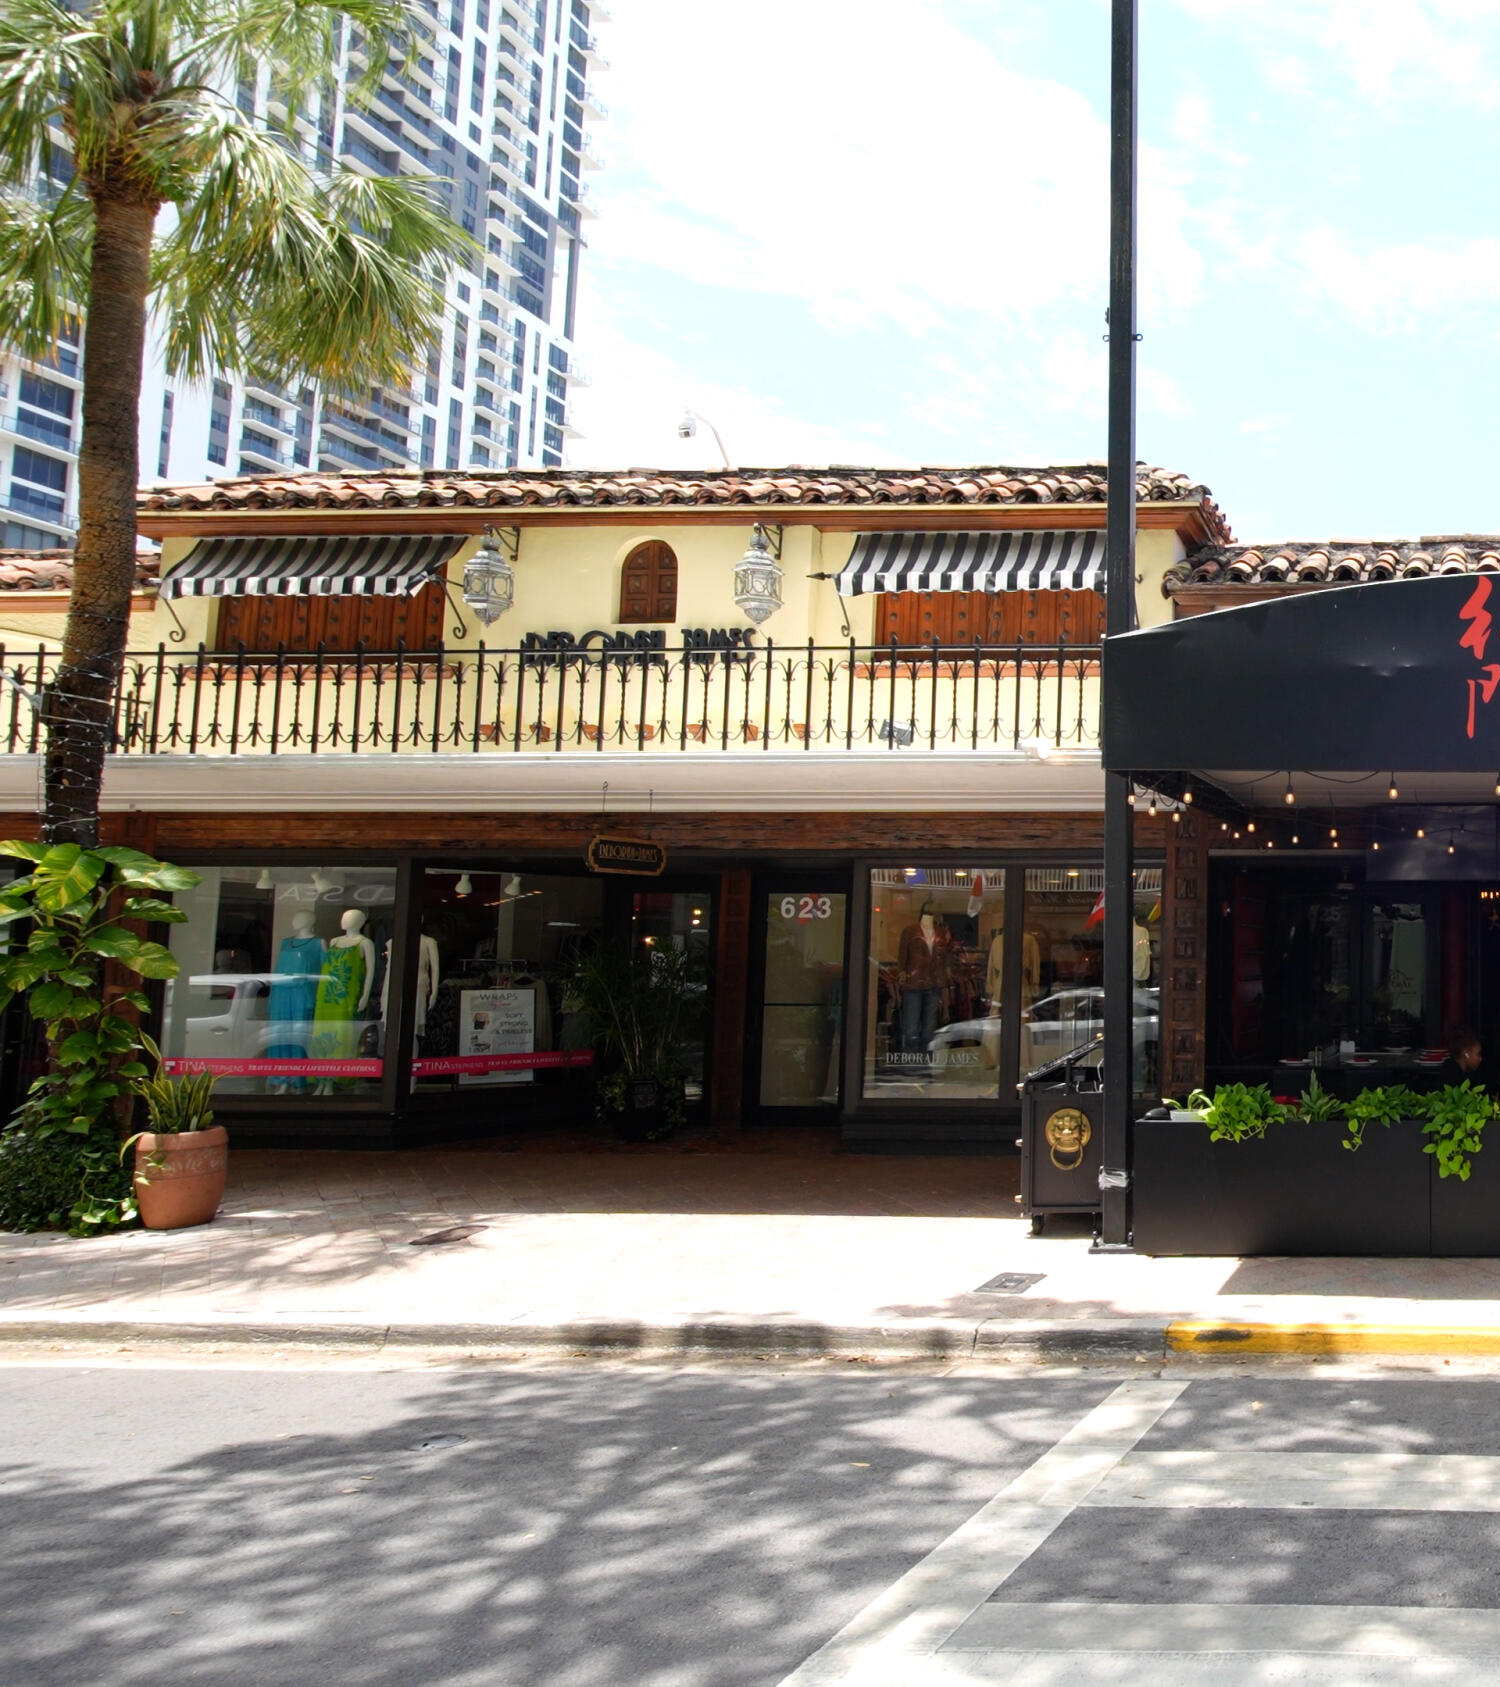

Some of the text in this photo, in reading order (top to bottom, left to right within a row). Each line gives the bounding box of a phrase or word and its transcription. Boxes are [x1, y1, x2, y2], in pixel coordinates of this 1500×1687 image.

[525, 627, 757, 667] DEBORAH JAMES
[780, 896, 832, 919] 623
[178, 1061, 206, 1072] TINA
[424, 1061, 450, 1071] TINA
